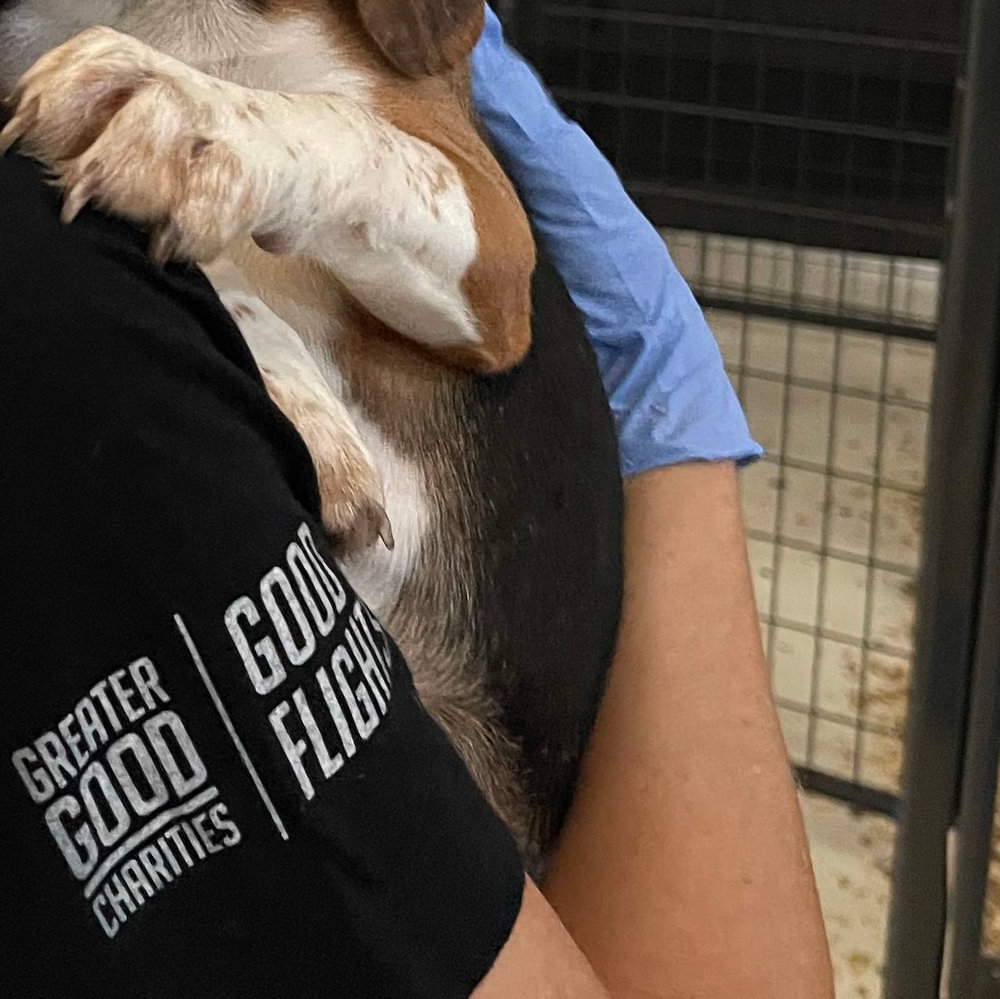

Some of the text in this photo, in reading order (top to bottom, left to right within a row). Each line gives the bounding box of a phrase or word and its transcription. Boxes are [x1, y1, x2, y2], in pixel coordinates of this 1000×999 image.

[224, 521, 346, 695] GOOD
[11, 656, 171, 804] GREATER
[45, 709, 208, 881] GOOD
[91, 802, 242, 939] CHARITIES
